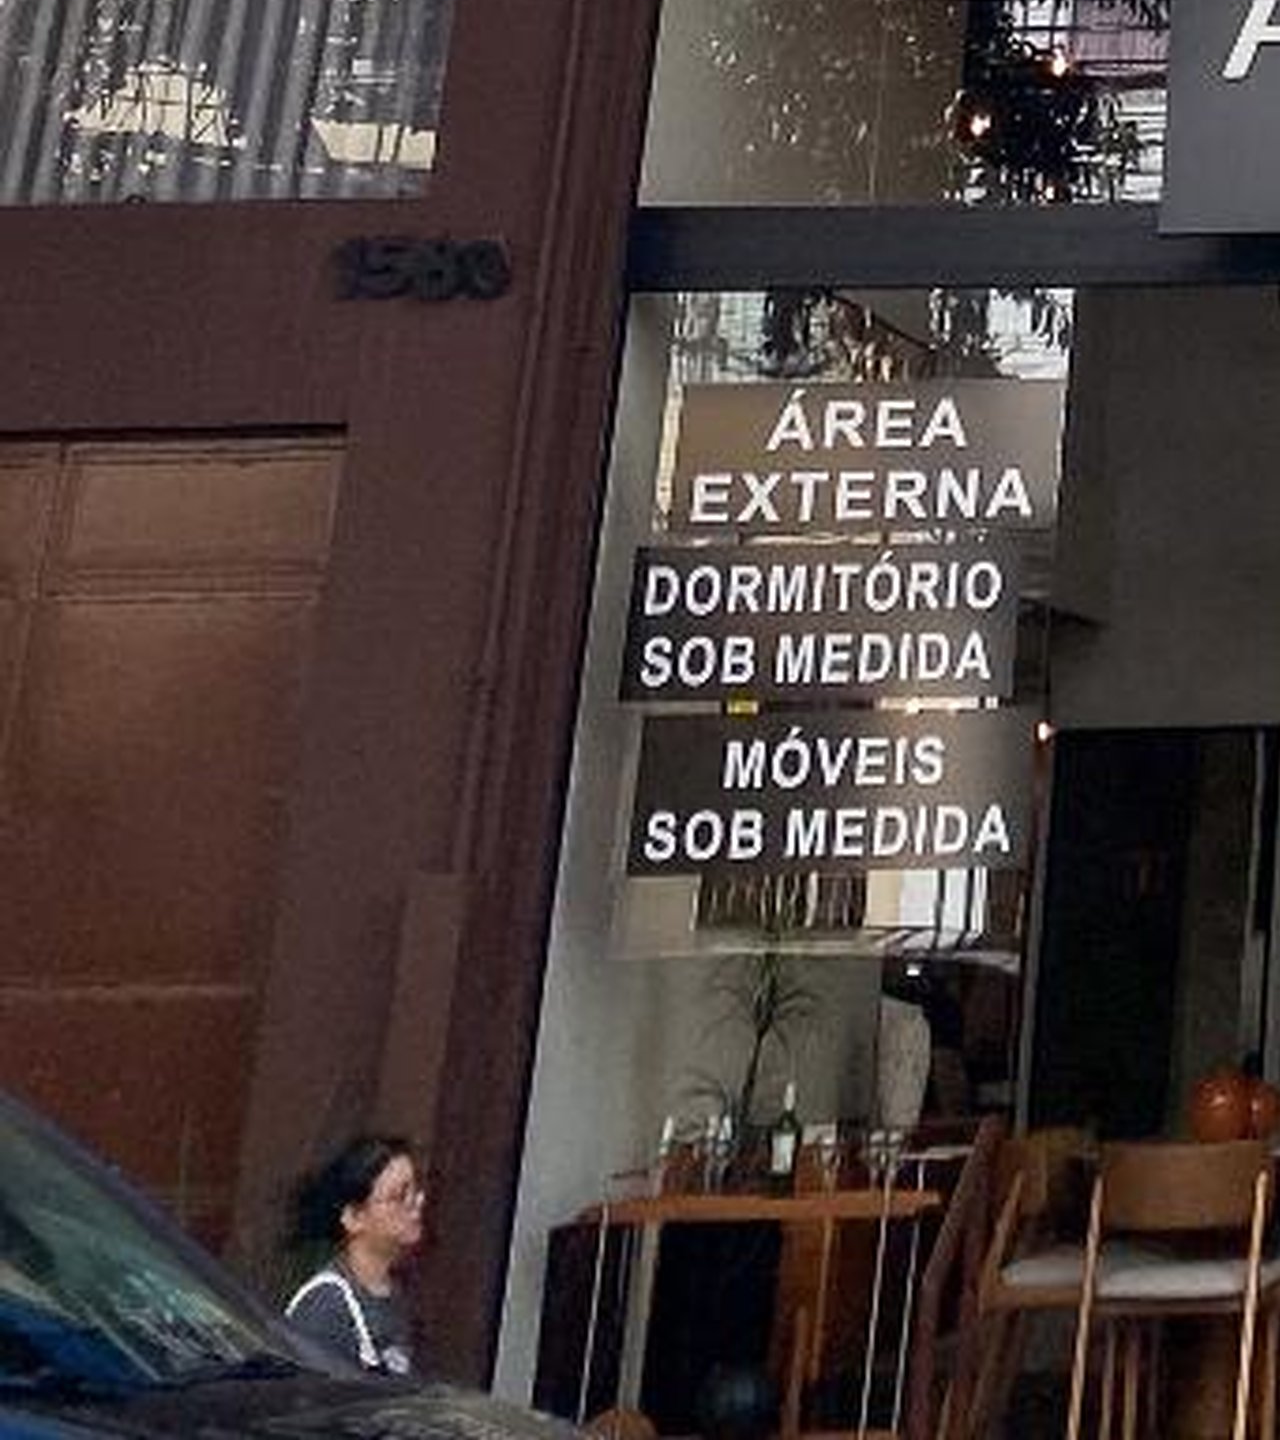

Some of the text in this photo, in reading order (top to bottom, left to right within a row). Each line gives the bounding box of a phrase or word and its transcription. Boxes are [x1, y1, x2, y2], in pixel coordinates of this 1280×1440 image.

[766, 390, 968, 451] ÁREA
[690, 468, 1033, 523] EXTERNA
[643, 553, 1003, 616] DORMITÓRIO
[640, 631, 992, 687] SOB MEDIDA
[722, 727, 945, 789] MÓVEIS
[642, 805, 1012, 862] SOB MEDIDA
